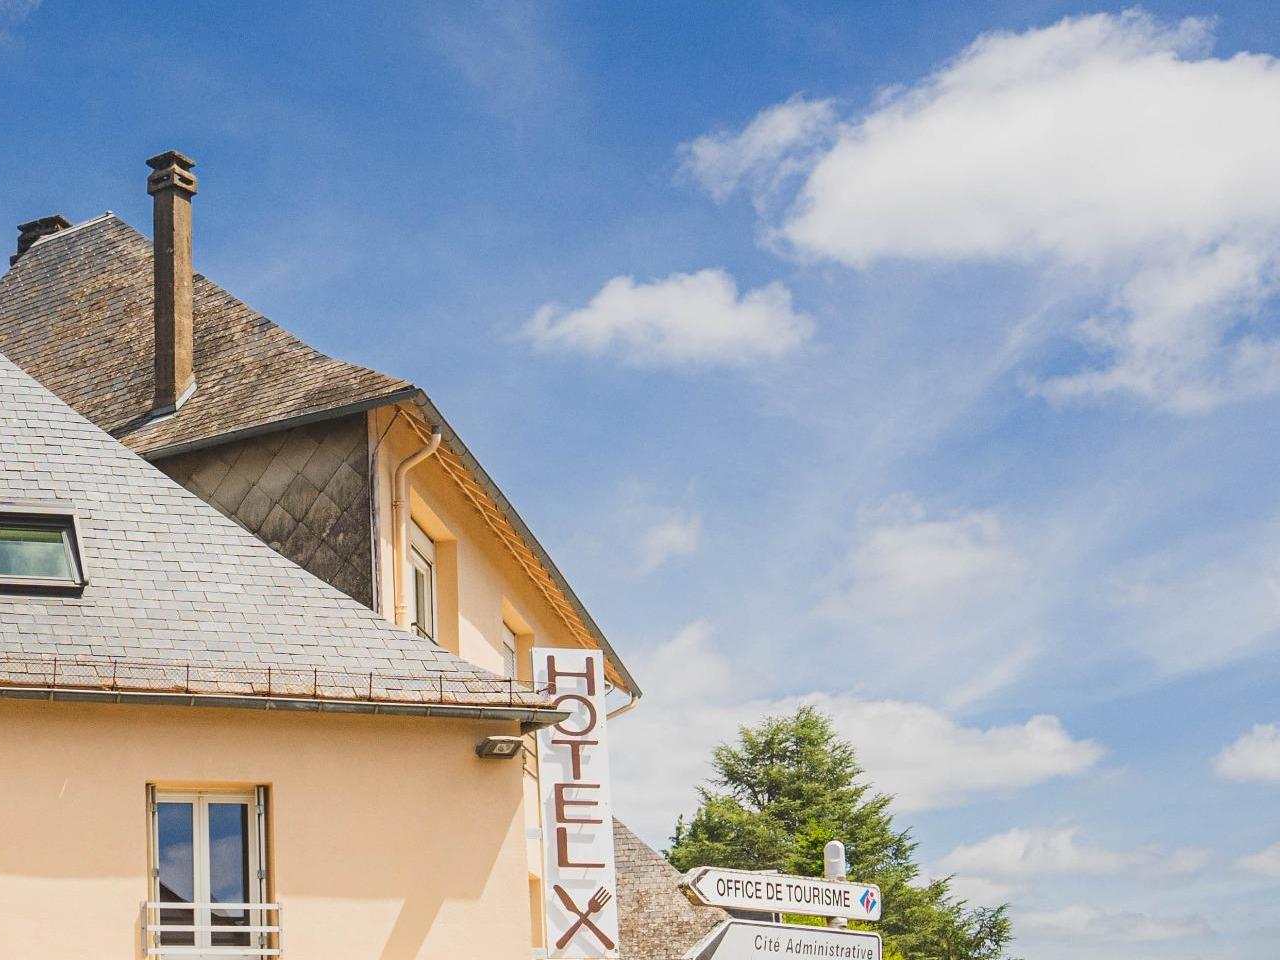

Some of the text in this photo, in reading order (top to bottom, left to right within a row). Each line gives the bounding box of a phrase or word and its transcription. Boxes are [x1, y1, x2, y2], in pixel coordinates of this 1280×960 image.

[547, 655, 605, 868] HOTEL
[716, 878, 851, 908] OFFICE DE TOURISME
[754, 934, 874, 960] Cité Administrative
